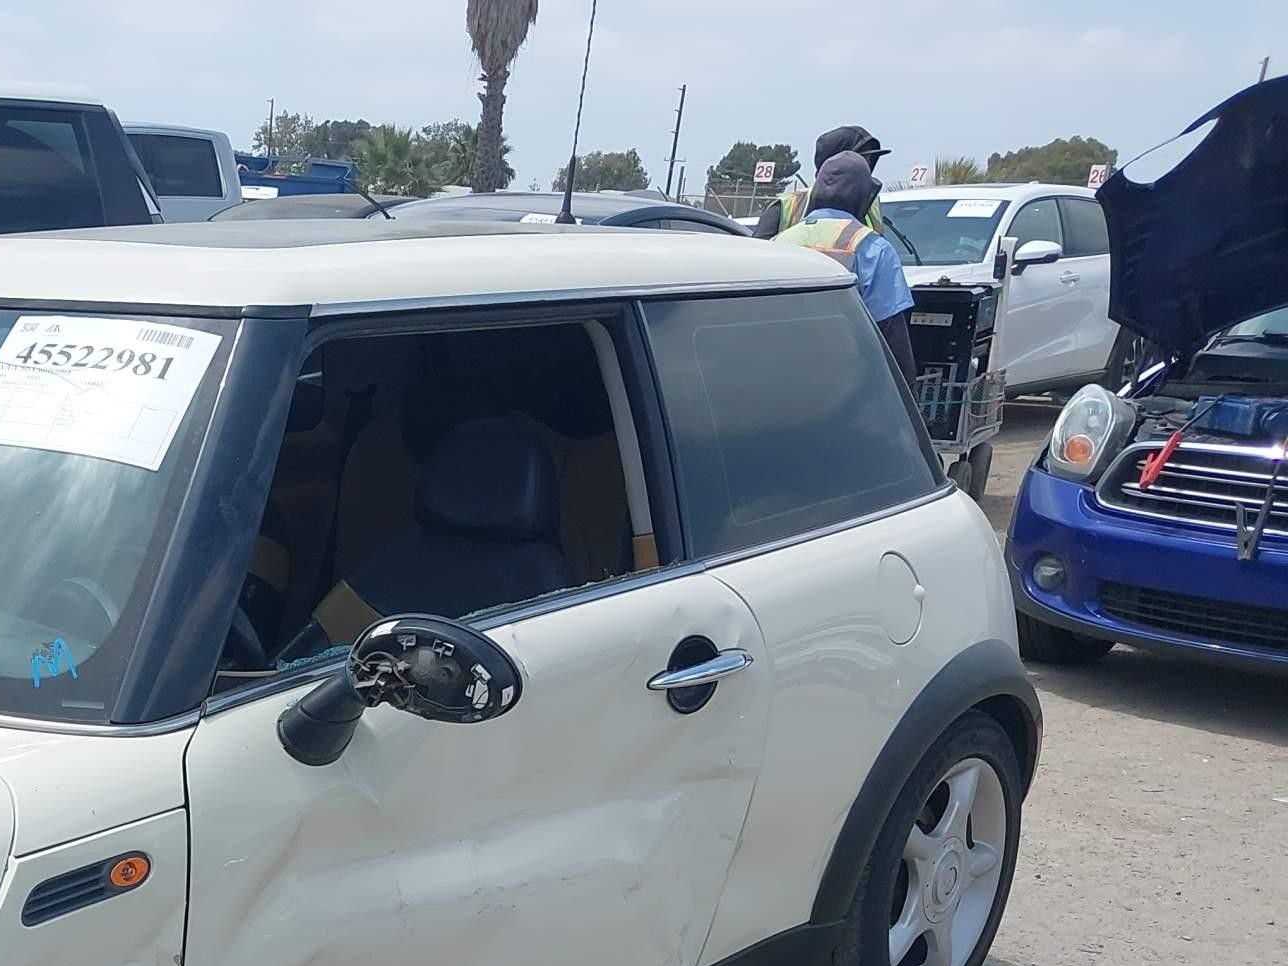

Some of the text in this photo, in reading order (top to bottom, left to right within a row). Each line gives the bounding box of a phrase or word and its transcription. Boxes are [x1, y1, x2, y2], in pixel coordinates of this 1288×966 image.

[755, 165, 773, 178] 28
[911, 167, 928, 182] 27
[15, 341, 174, 381] 45522981
